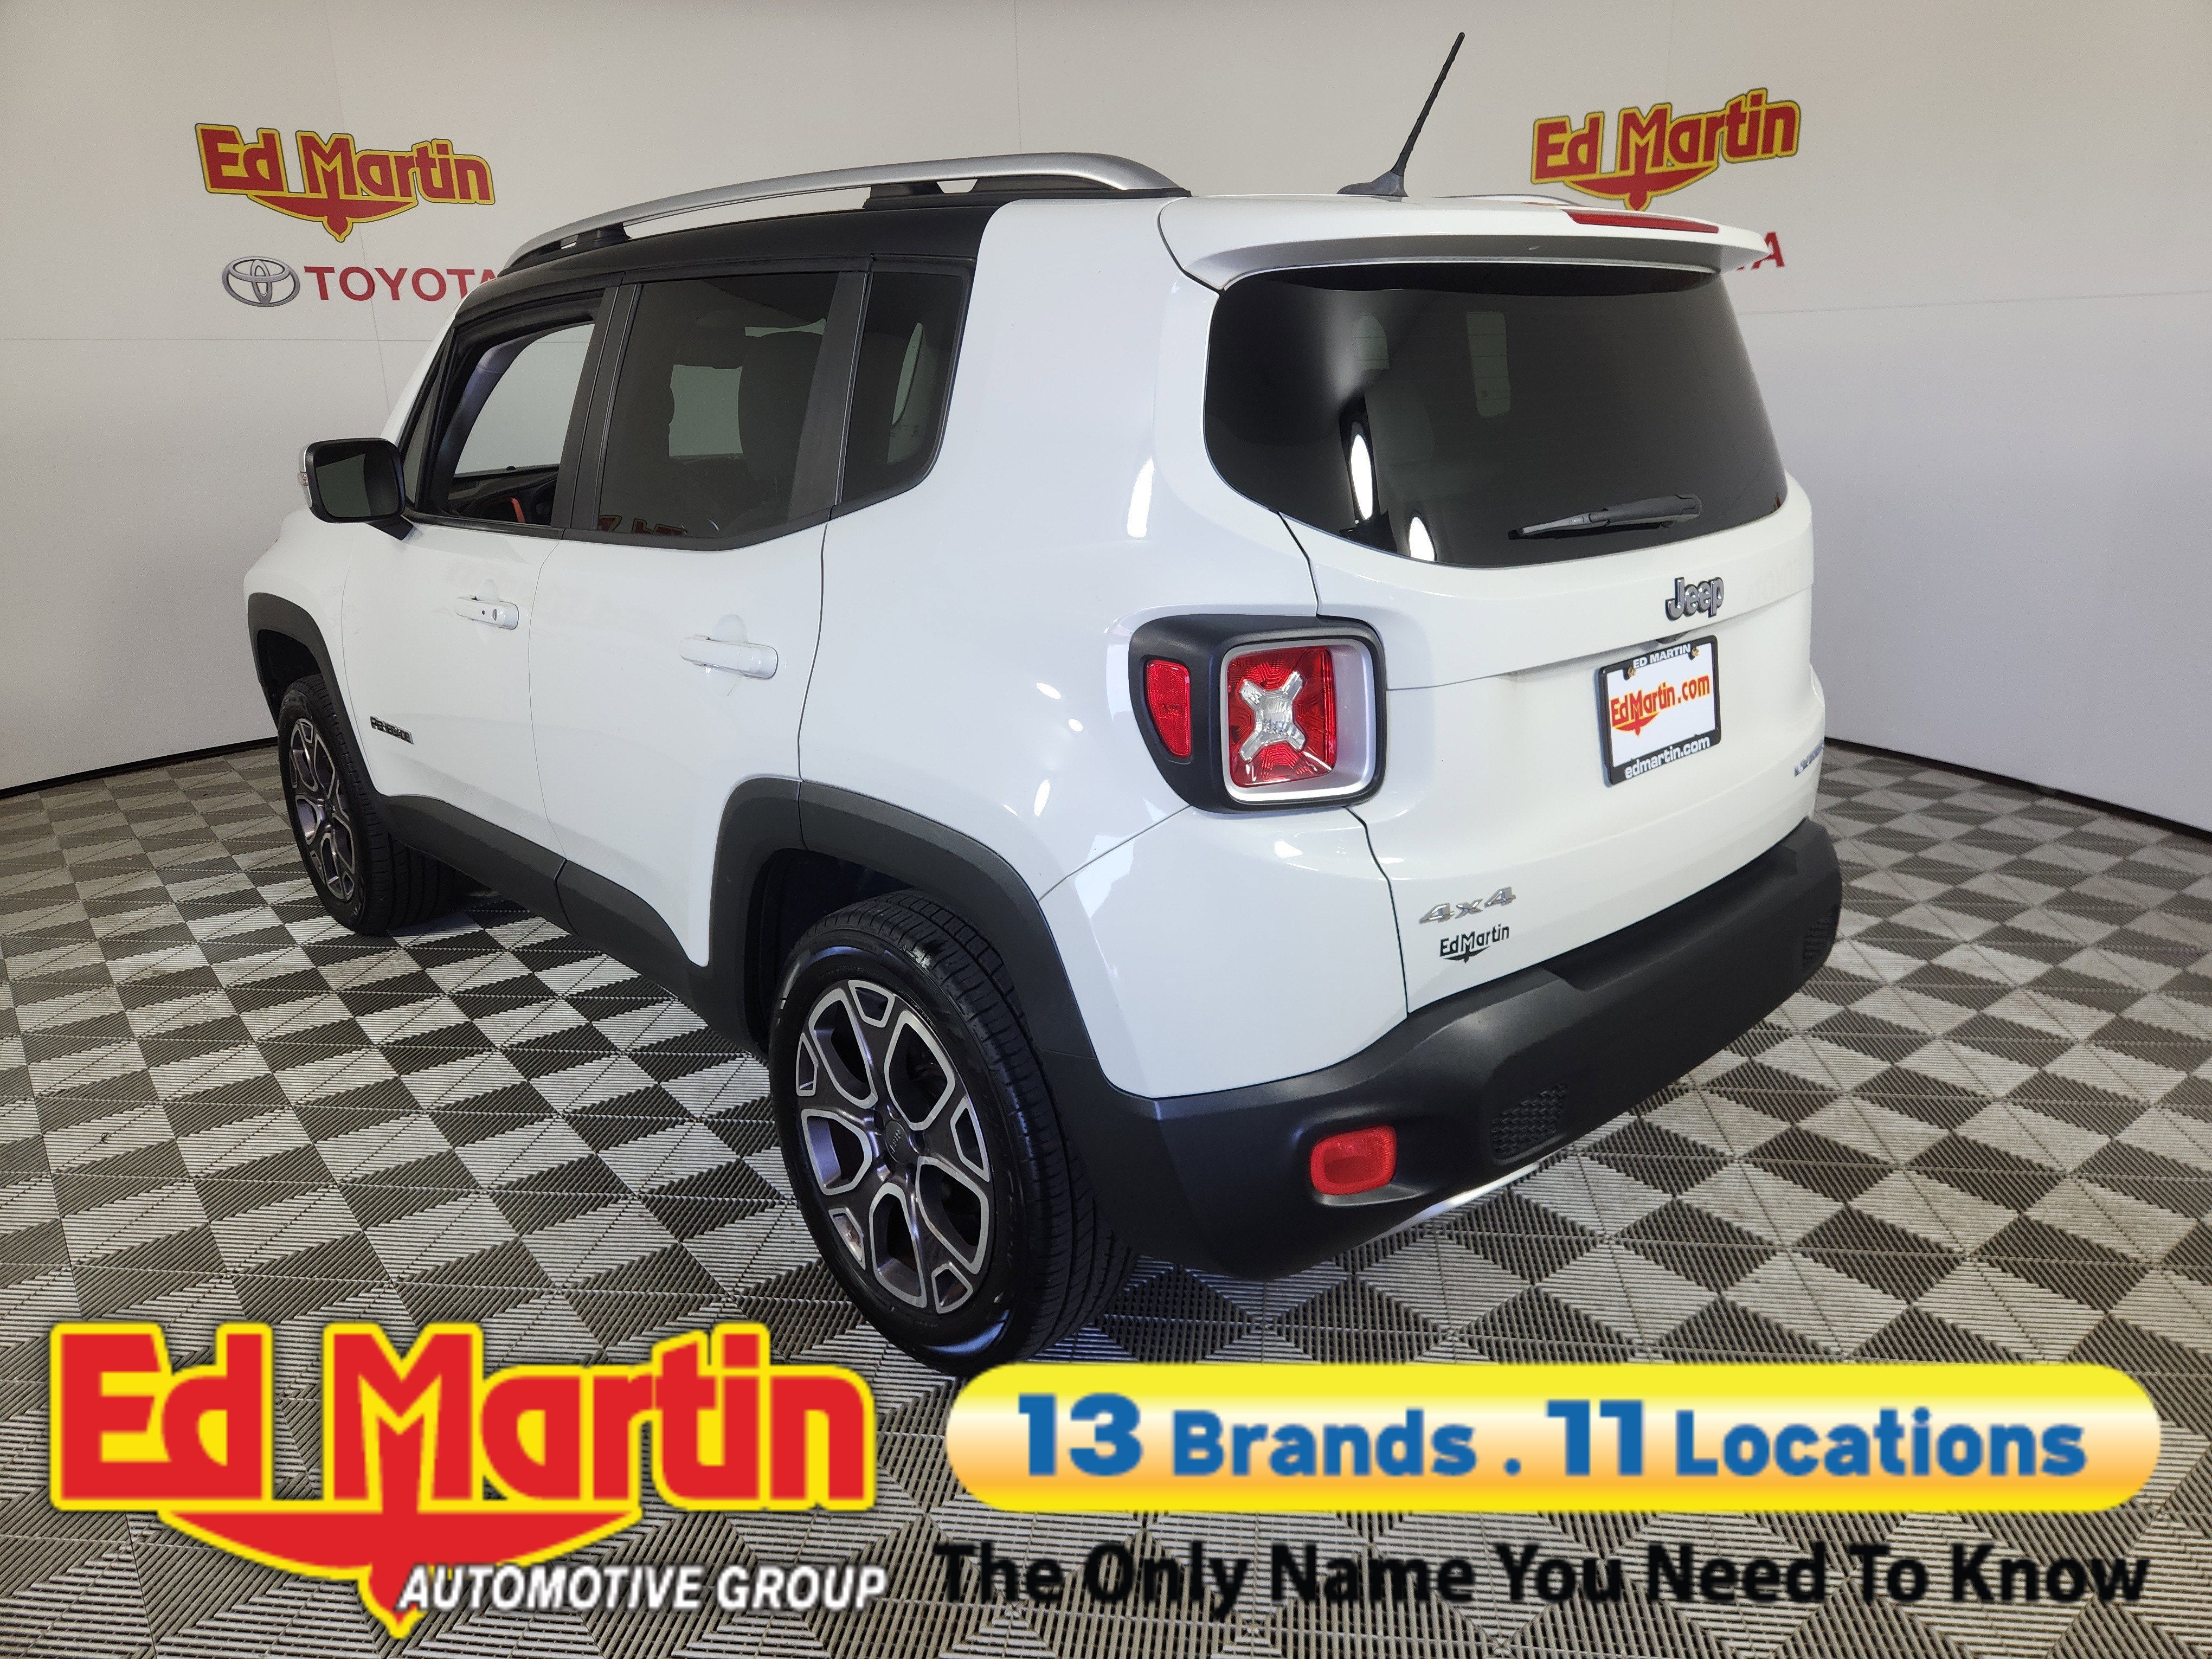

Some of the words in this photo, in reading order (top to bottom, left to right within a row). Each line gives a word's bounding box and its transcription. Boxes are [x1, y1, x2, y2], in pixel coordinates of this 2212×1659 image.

[1531, 112, 1604, 184] Ed
[1617, 88, 1801, 179] Martin
[195, 124, 286, 194] Ed
[295, 131, 496, 205] Martin
[304, 266, 497, 301] TOYOT
[1666, 577, 1725, 621] Jeep
[1633, 657, 1648, 668] ED
[1650, 644, 1691, 664] MARTIN
[1625, 736, 1710, 779] edmartin.com
